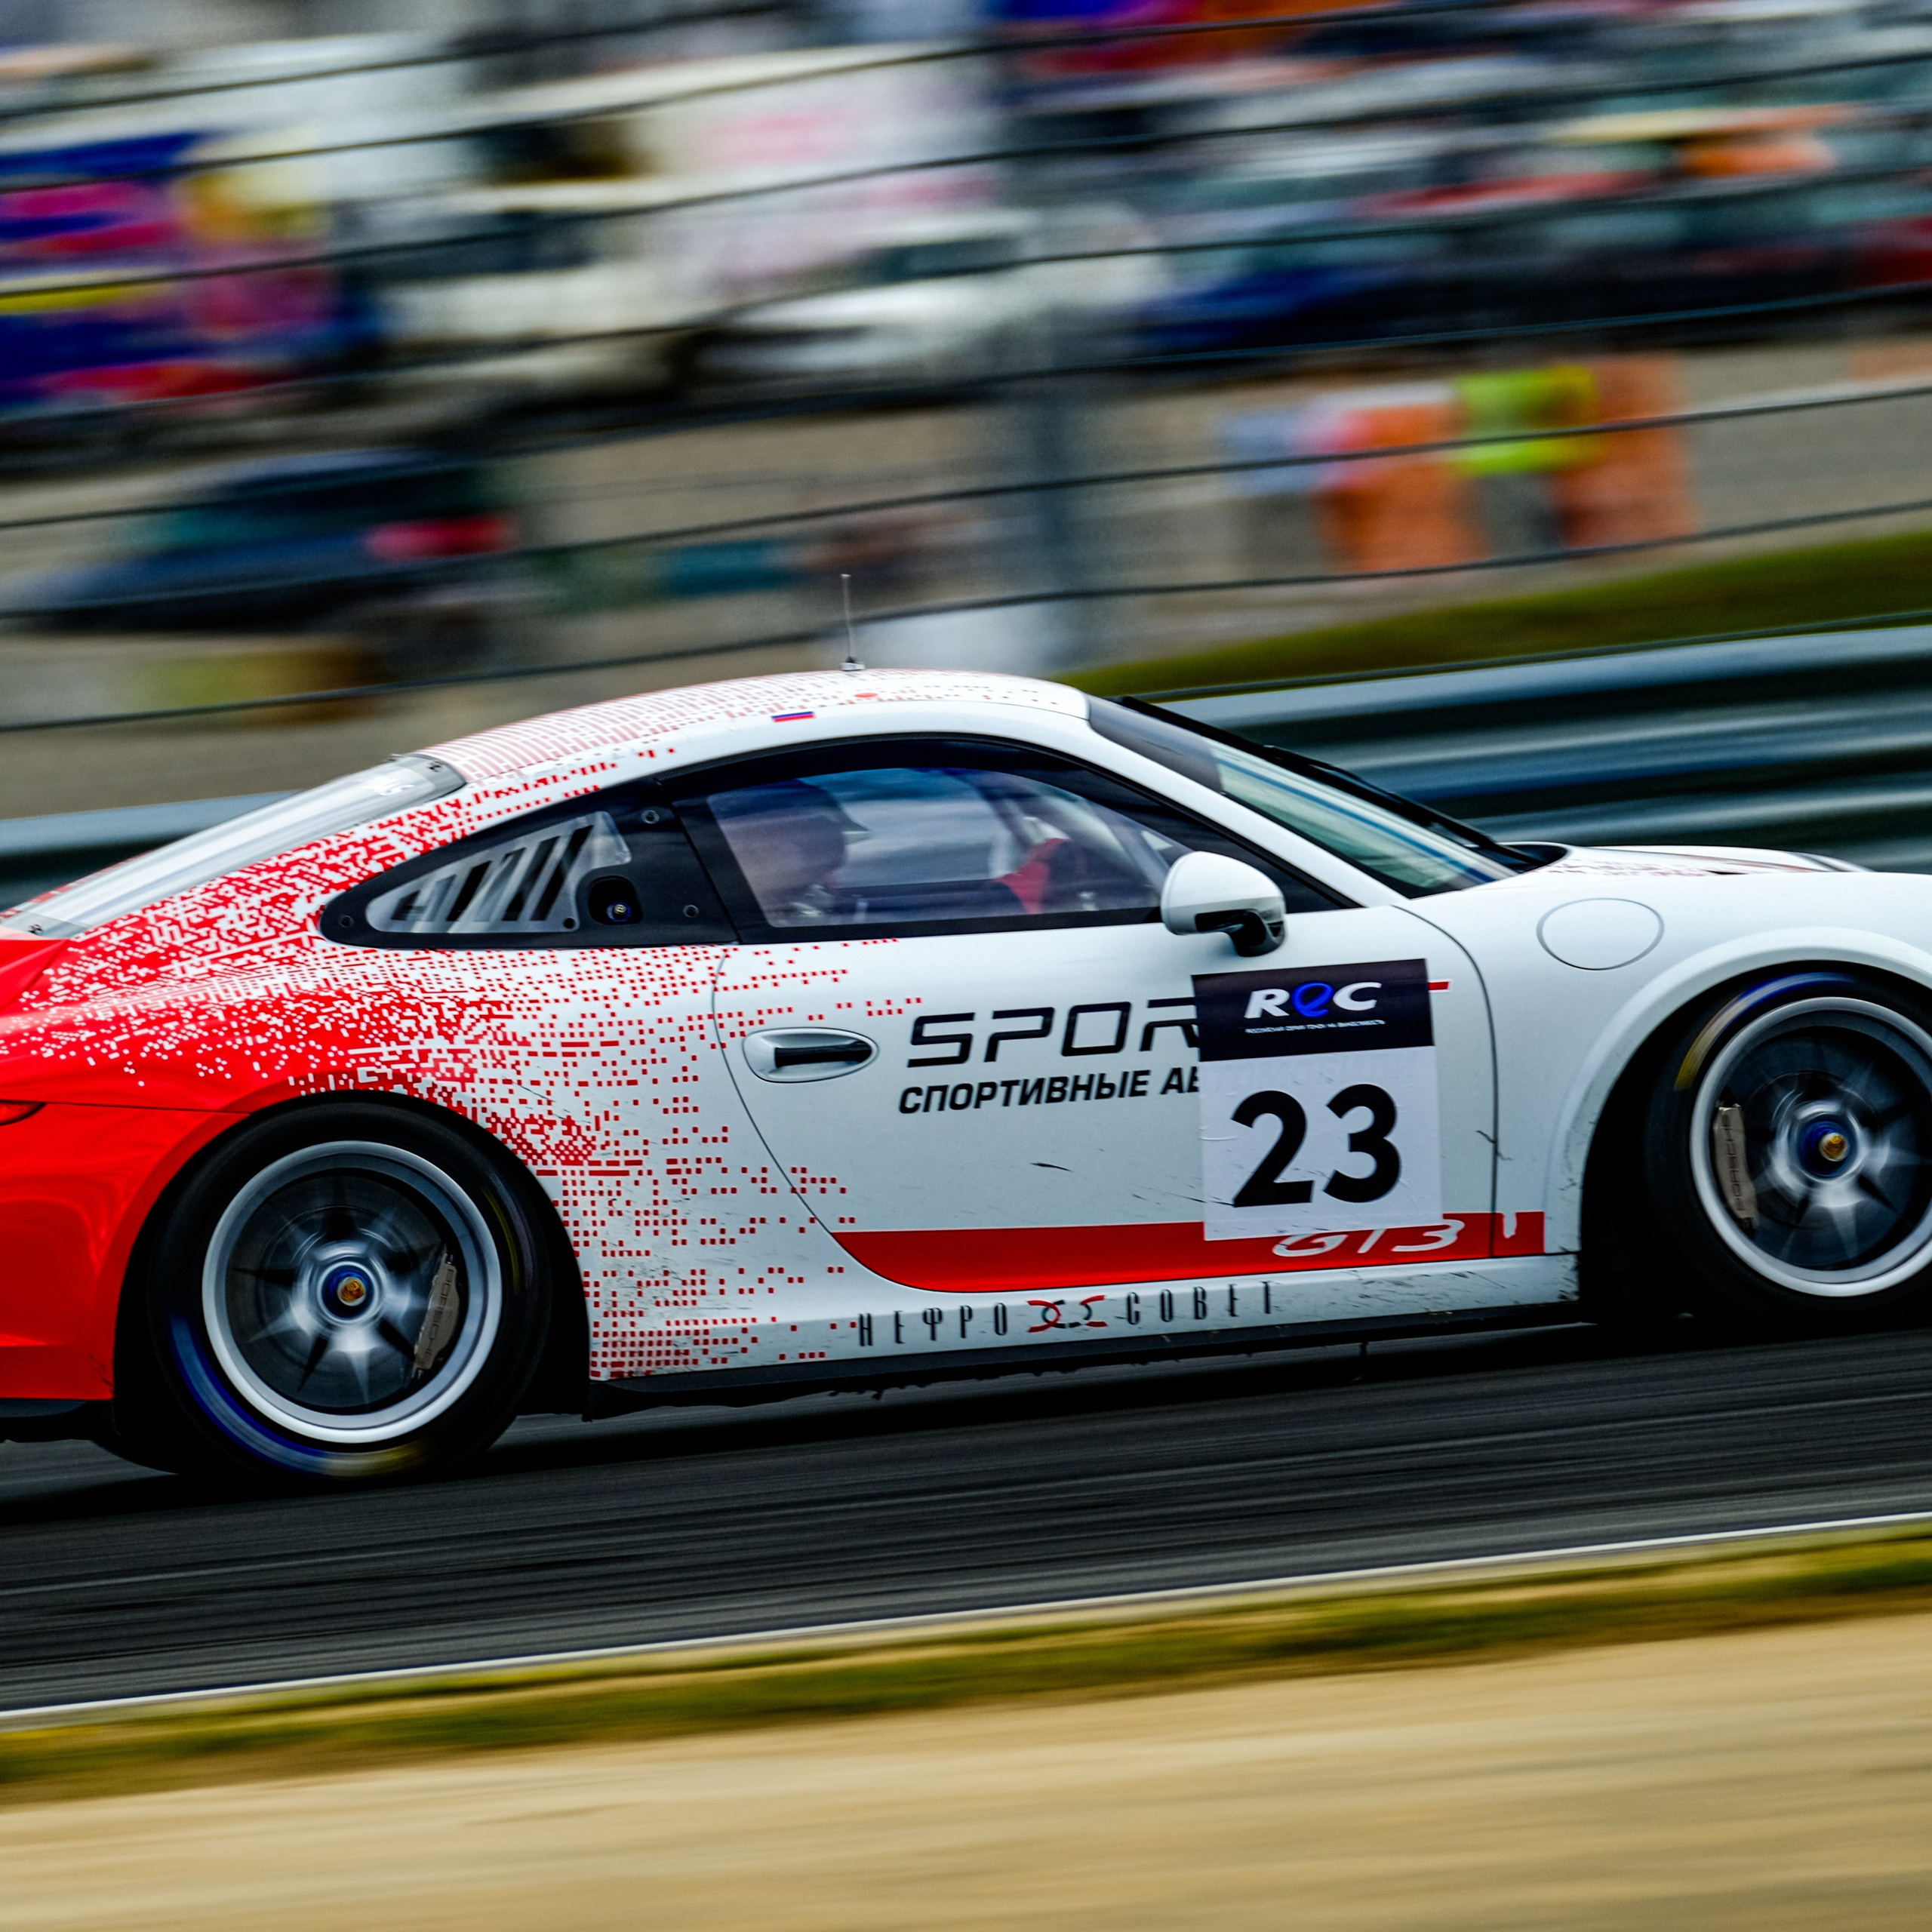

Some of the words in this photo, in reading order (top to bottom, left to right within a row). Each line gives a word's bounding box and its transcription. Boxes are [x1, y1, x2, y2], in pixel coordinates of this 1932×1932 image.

[906, 996, 1200, 1068] SPOR
[898, 1069, 1152, 1115] СПОРТИВНЫЕ
[1230, 1083, 1402, 1208] 23
[857, 1302, 1008, 1347] НЕФРО
[1126, 1281, 1275, 1325] СОВЕТ
